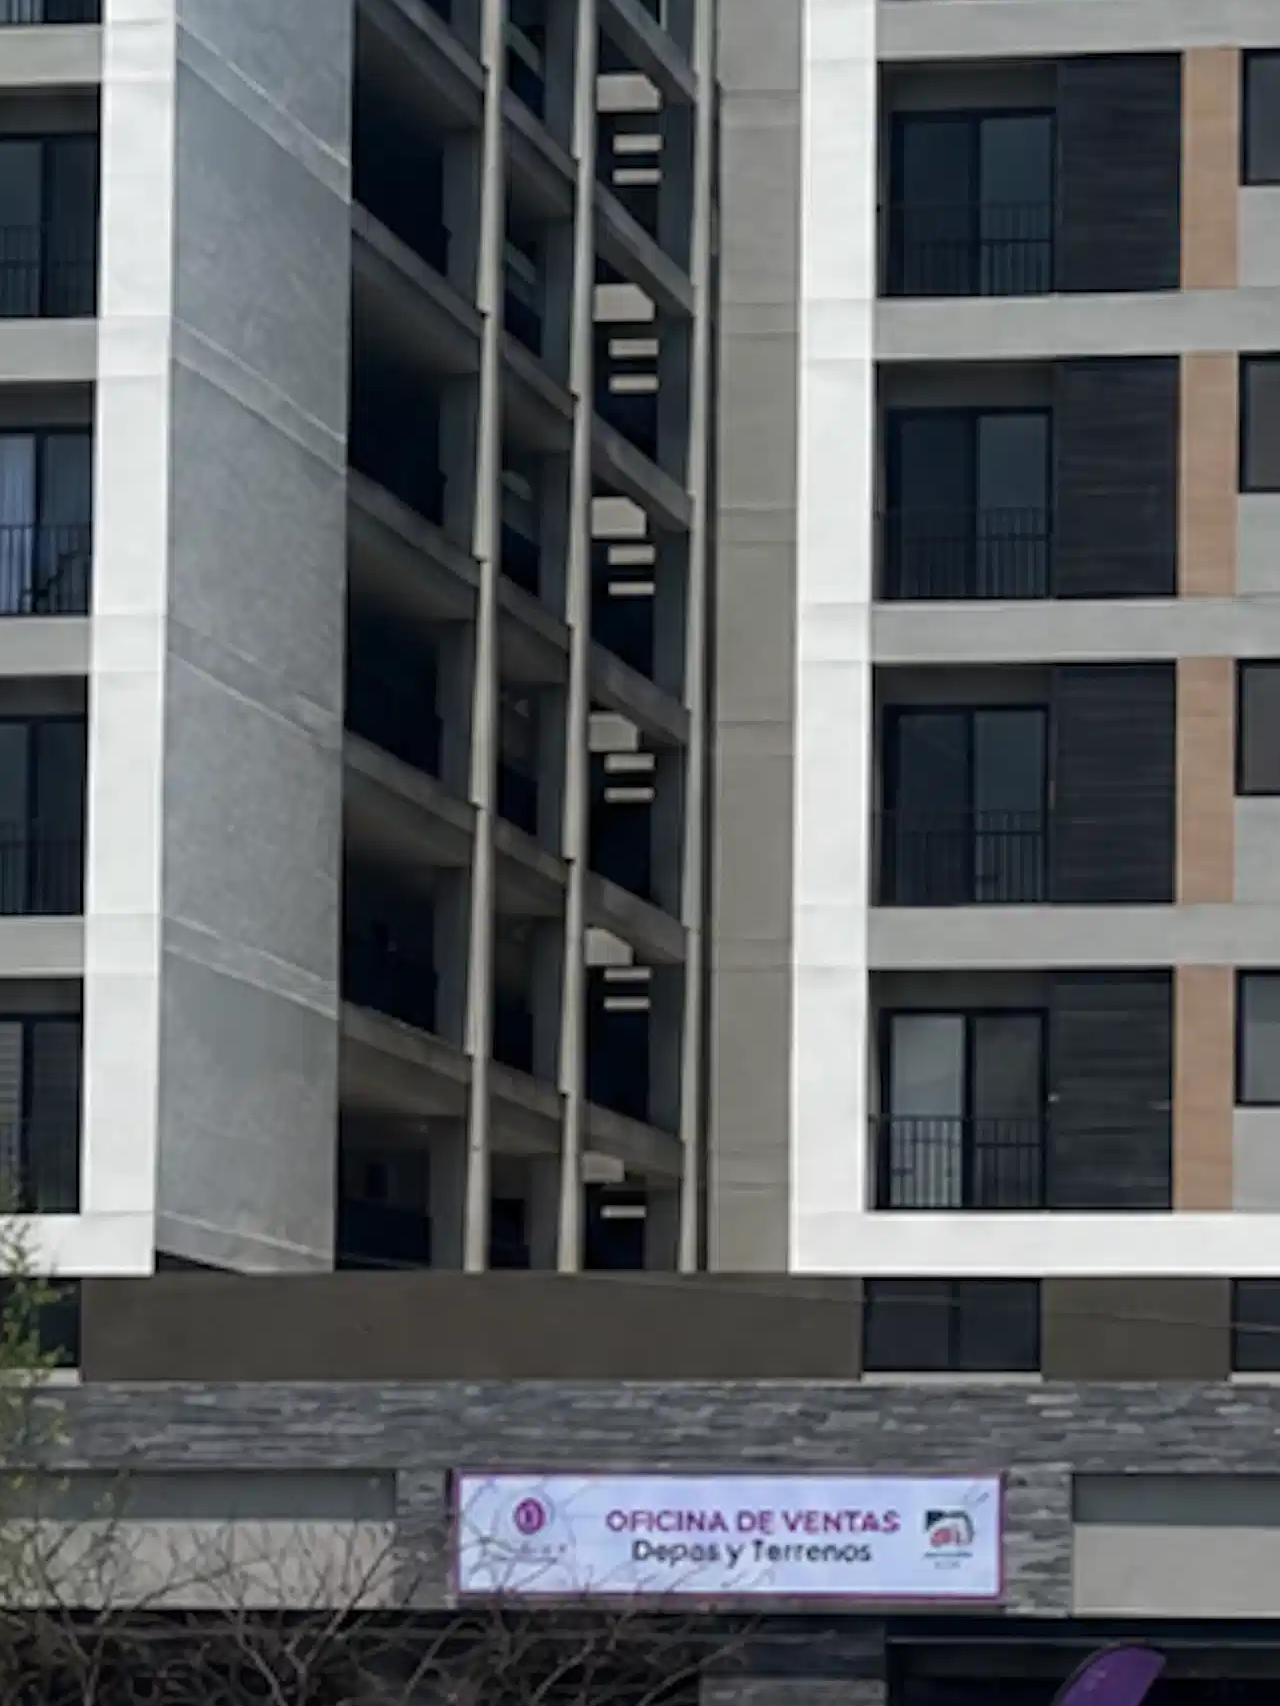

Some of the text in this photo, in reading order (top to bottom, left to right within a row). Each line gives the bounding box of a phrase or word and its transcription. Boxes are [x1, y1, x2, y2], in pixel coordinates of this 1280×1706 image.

[605, 1509, 901, 1534] OFICINA DE VENTAS
[631, 1539, 873, 1569] Depas y Terrenos
